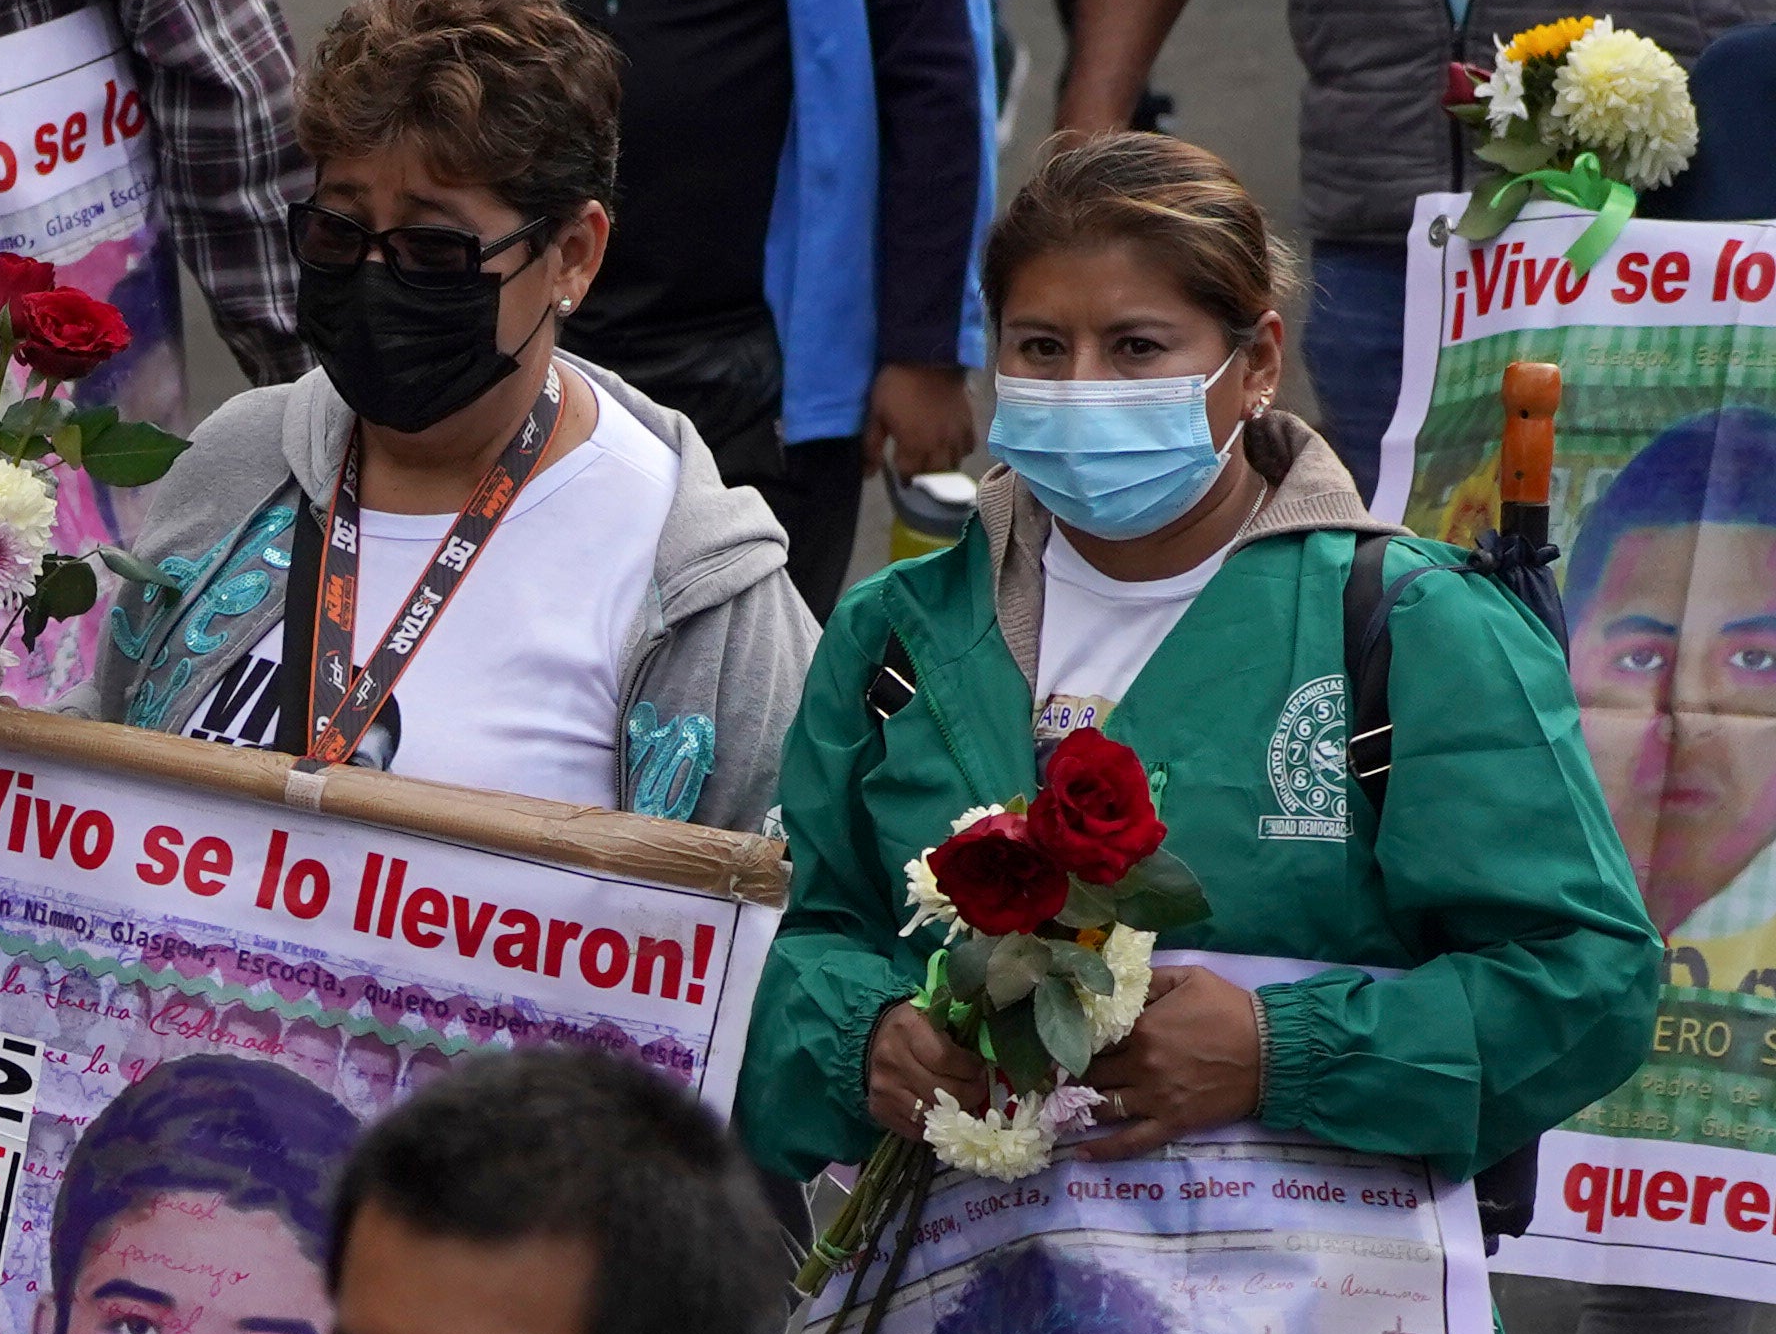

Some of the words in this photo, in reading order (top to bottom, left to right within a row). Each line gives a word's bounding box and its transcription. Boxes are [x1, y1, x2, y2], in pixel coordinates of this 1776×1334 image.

[34, 111, 88, 176] se
[101, 79, 148, 148] lo
[45, 204, 106, 238] Glasgow
[1611, 250, 1691, 305] se
[1711, 238, 1776, 304] lo
[1298, 720, 1312, 738] 6
[1316, 702, 1331, 718] 5
[1272, 731, 1287, 753] DE
[1291, 744, 1303, 761] 7
[1270, 751, 1301, 814] SINDICATO
[1294, 769, 1307, 789] 8
[1311, 790, 1326, 809] 9
[135, 821, 233, 897] se
[254, 828, 331, 921] lo
[352, 850, 717, 1007] llevaron!
[21, 898, 97, 942] Nimmo,
[109, 919, 218, 968] Glasgow,
[236, 949, 348, 998] Escocia,
[362, 980, 448, 1018] quiero
[464, 1004, 535, 1037] saber
[1652, 1015, 1734, 1058] ERO
[963, 1186, 1051, 1224] Escocia,
[1066, 1175, 1165, 1217] quiero
[1177, 1176, 1257, 1201] saber
[1270, 1176, 1348, 1205] dónde
[1360, 1184, 1420, 1211] está
[1562, 1161, 1776, 1235] quere
